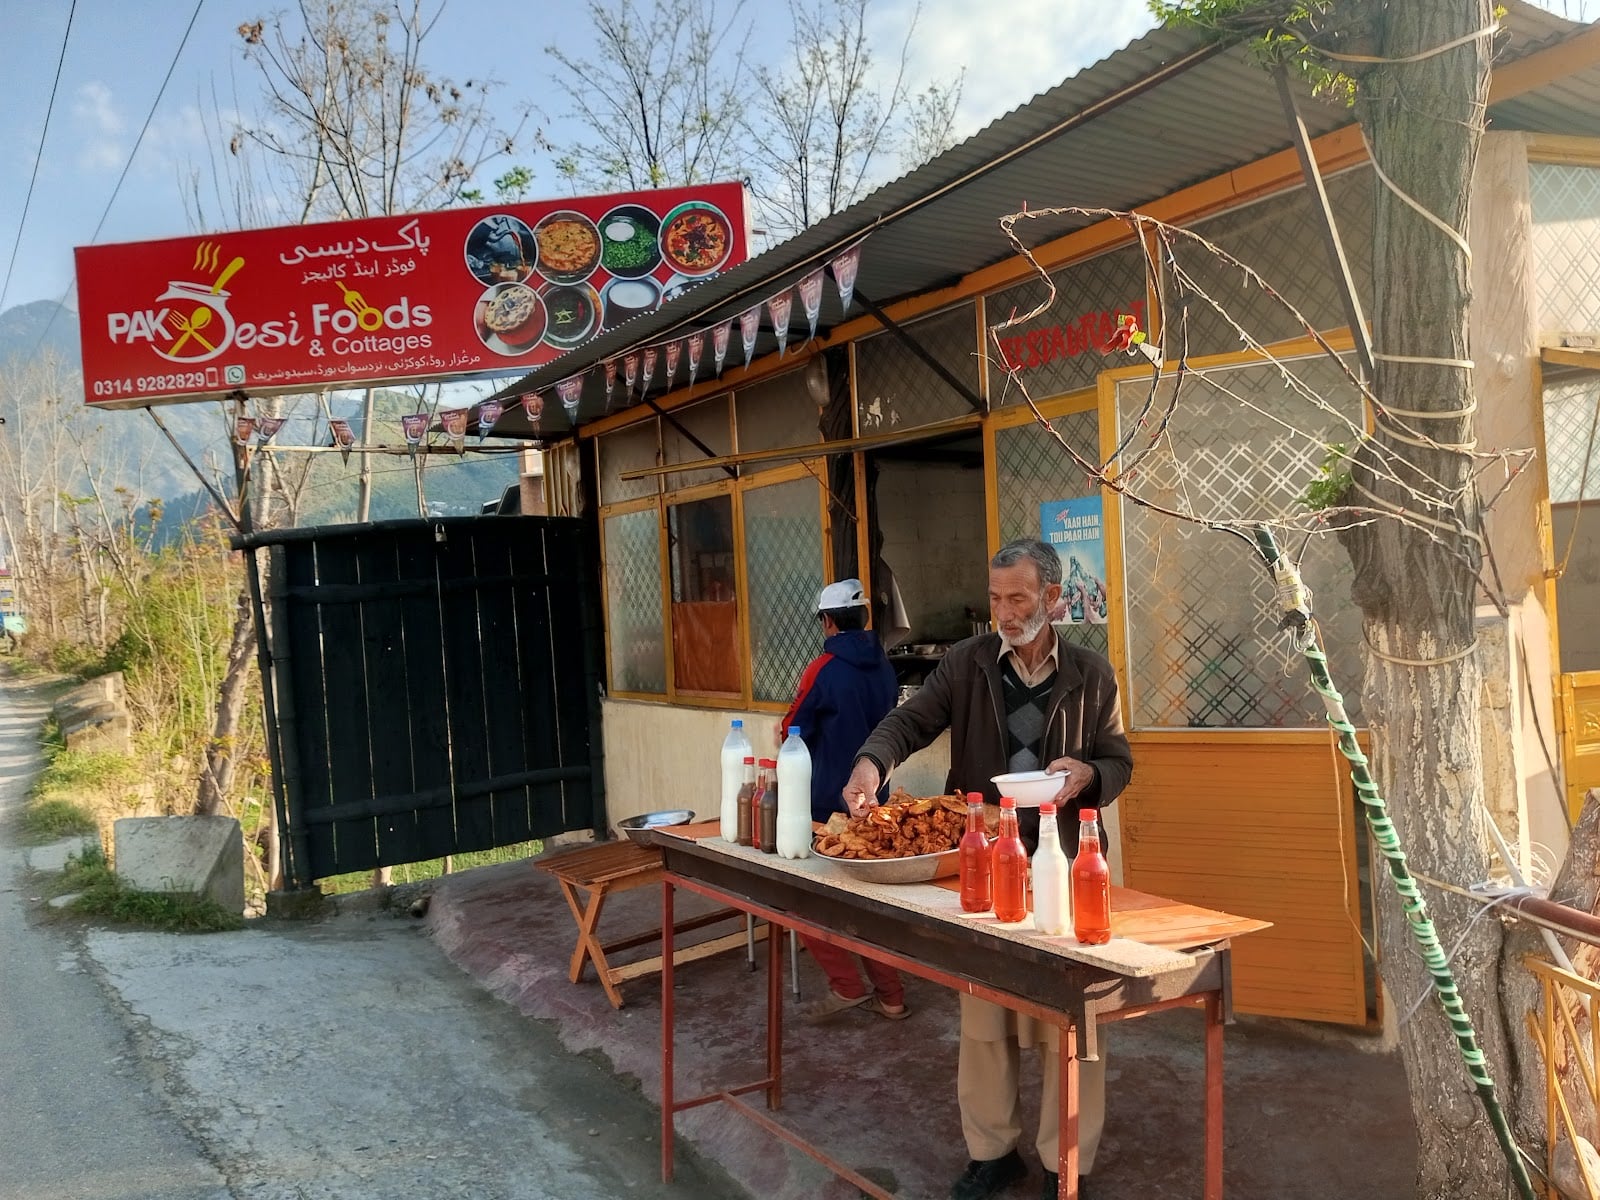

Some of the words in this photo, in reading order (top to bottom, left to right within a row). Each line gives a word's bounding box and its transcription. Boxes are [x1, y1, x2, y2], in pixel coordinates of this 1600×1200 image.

[279, 237, 370, 265] دیسی
[371, 218, 431, 256] پاک
[107, 307, 173, 344] PAK
[312, 296, 433, 336] Foods
[308, 339, 325, 357] &
[332, 334, 433, 356] Cottages
[94, 378, 133, 396] 0314
[137, 372, 206, 392] 9282829
